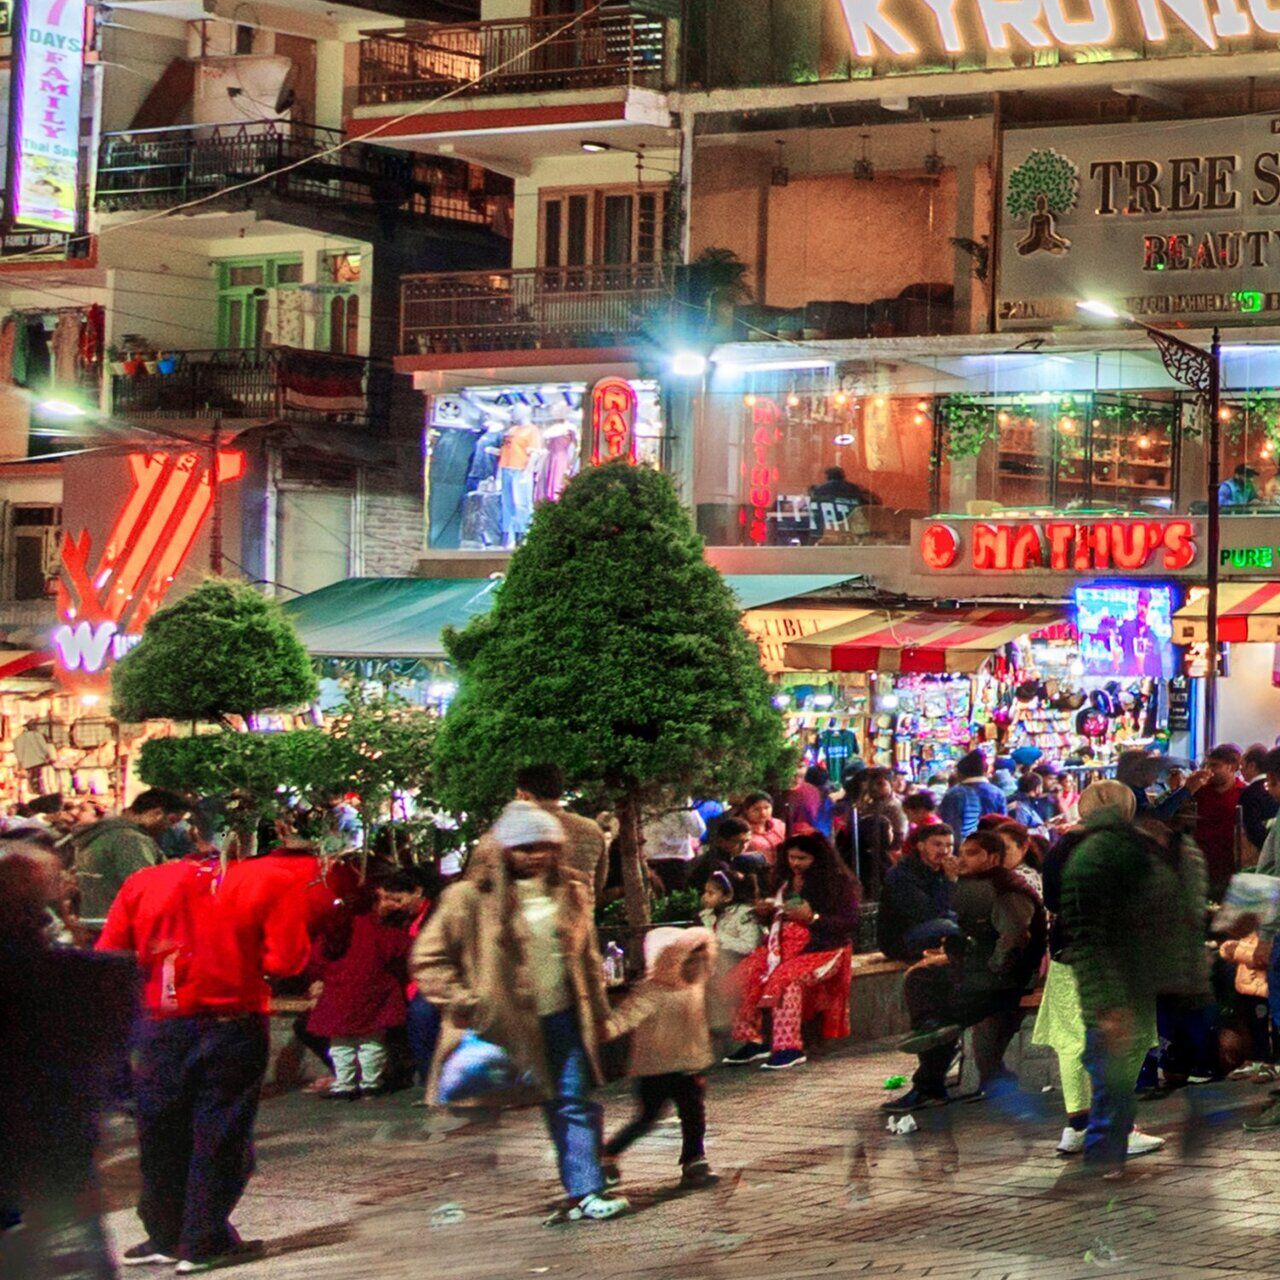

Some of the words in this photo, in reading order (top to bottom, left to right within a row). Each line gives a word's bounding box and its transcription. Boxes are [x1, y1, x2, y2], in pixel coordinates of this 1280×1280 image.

[30, 29, 82, 53] DAYS
[40, 50, 69, 139] FAMILY
[1090, 155, 1241, 214] TREE
[972, 523, 1198, 570] NATHU'S
[1220, 547, 1273, 568] PURE
